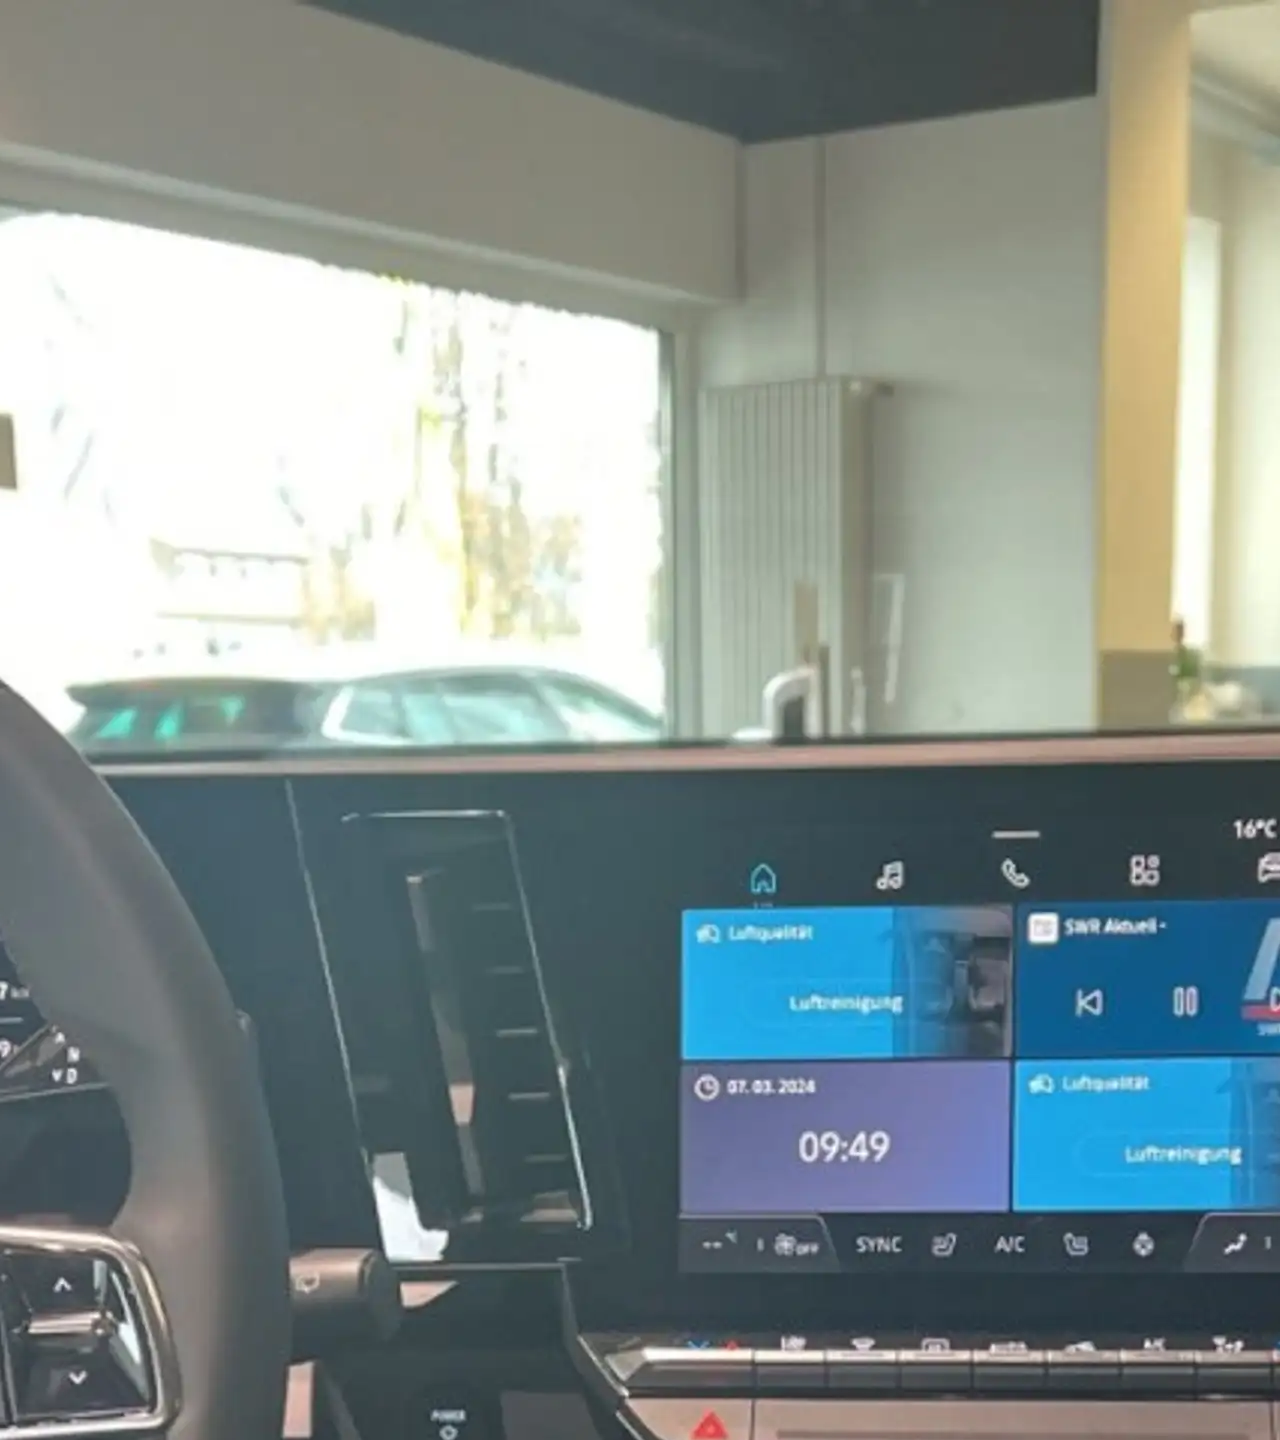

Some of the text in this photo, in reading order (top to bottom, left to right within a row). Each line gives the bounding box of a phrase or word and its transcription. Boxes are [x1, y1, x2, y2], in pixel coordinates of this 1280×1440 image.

[1233, 818, 1278, 839] 16°C
[728, 924, 814, 943] Luftqualität
[1064, 918, 1101, 936] SWR
[1103, 917, 1158, 935] Aktuell
[788, 994, 904, 1015] Luftreinigung
[66, 1067, 78, 1085] D
[1062, 1074, 1150, 1092] Luftqualität
[798, 1130, 892, 1163] 09:49
[1124, 1145, 1243, 1165] Luftreinigung
[855, 1235, 904, 1254] SYNC
[994, 1235, 1026, 1253] A/C
